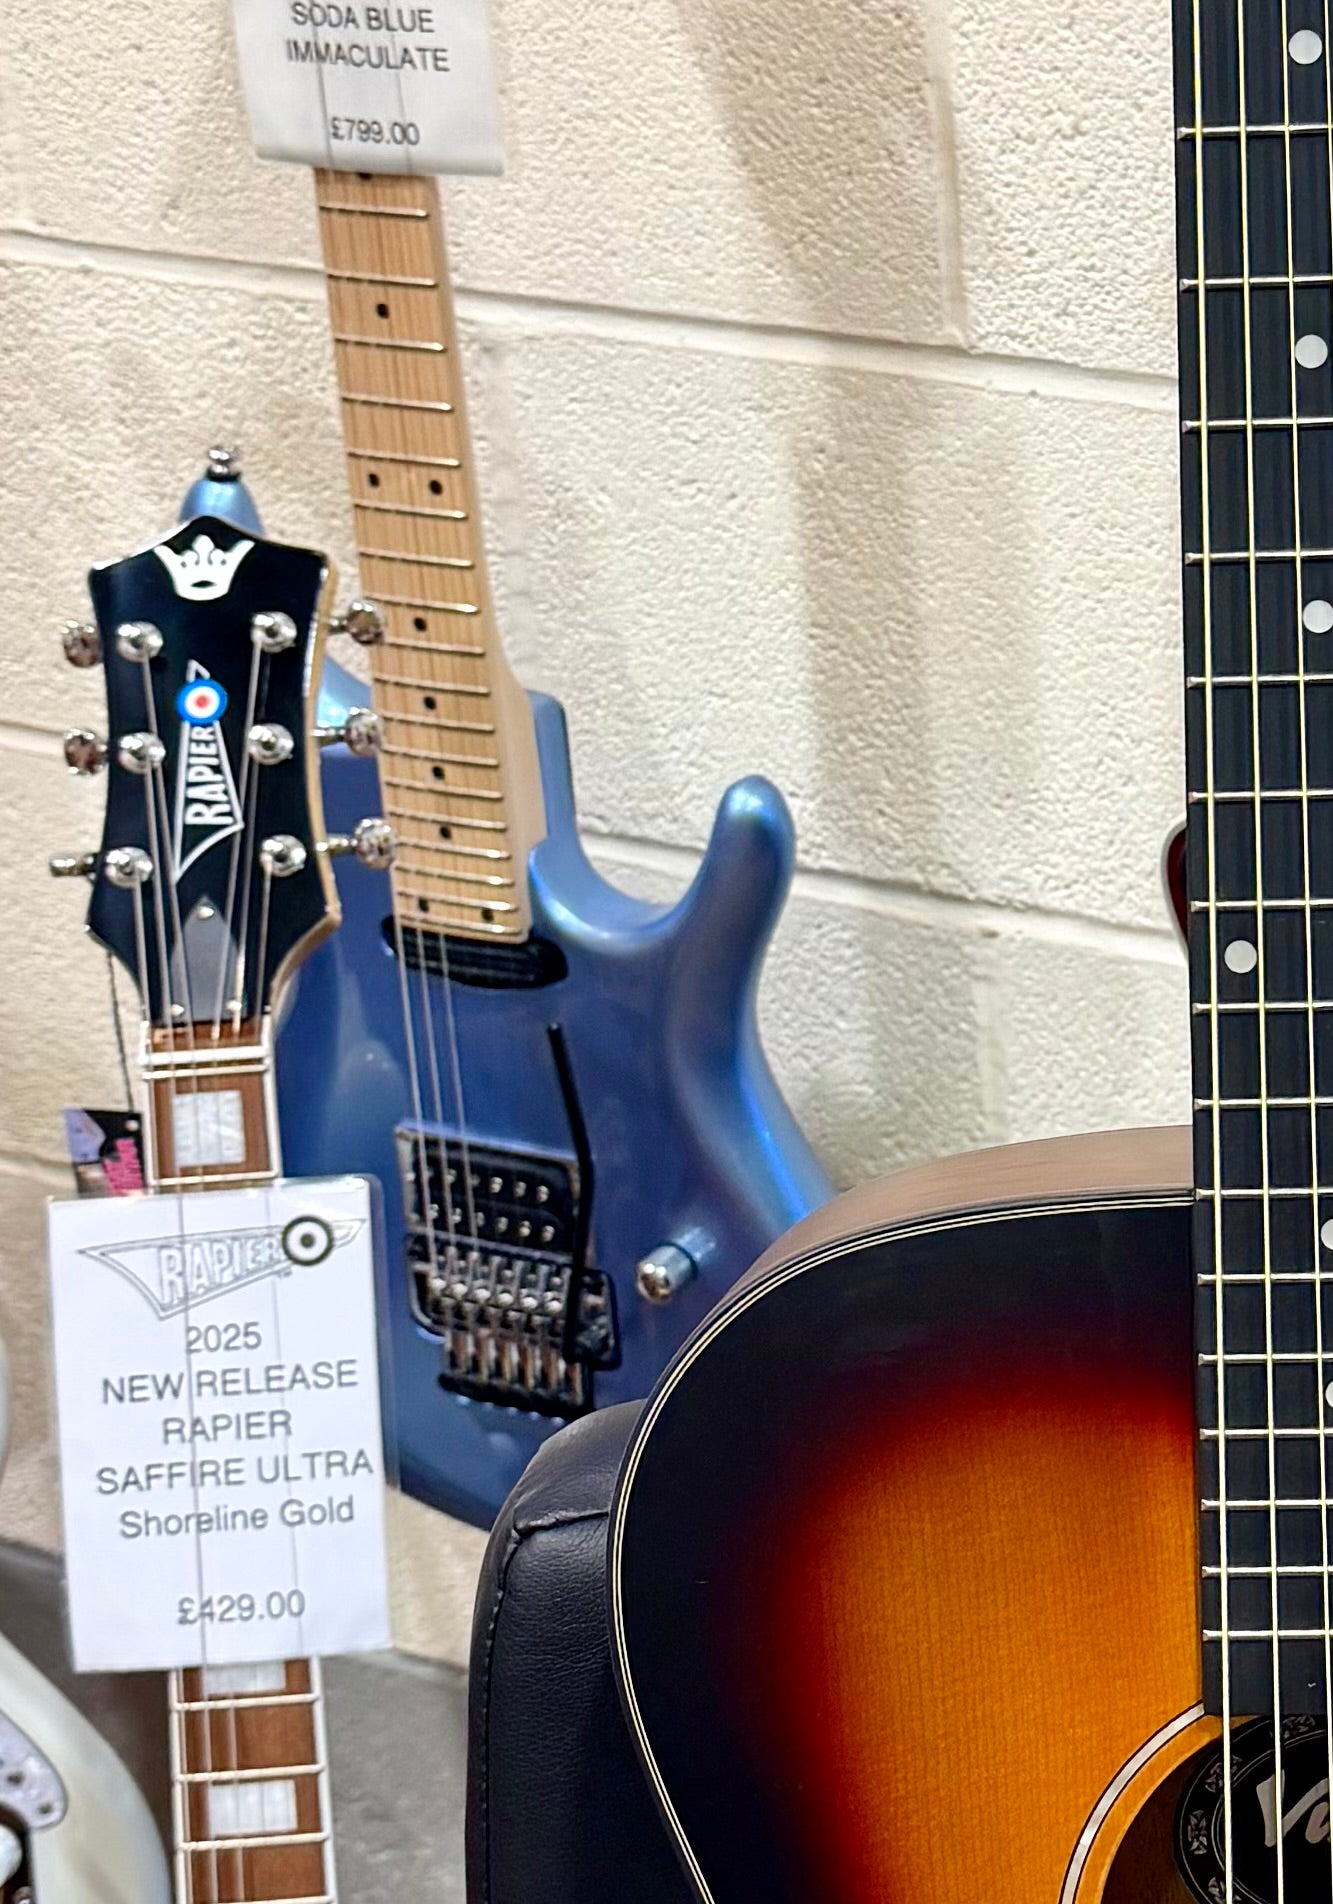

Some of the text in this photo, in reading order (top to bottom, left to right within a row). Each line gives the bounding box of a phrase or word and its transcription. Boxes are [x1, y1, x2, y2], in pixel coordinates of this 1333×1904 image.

[291, 2, 434, 34] SODA BLUE
[286, 39, 451, 72] IMMACULATE
[331, 117, 420, 146] £799.00
[185, 726, 234, 825] RAPIER
[157, 1235, 284, 1309] RAPIER
[186, 1322, 262, 1354] 2025
[102, 1360, 359, 1404] NEW RELEASE
[163, 1410, 292, 1444] RAPIER
[97, 1449, 373, 1495] SAFFIRE ULTRA
[119, 1496, 354, 1539] Shoreline Gold
[177, 1589, 305, 1625] £429.00
